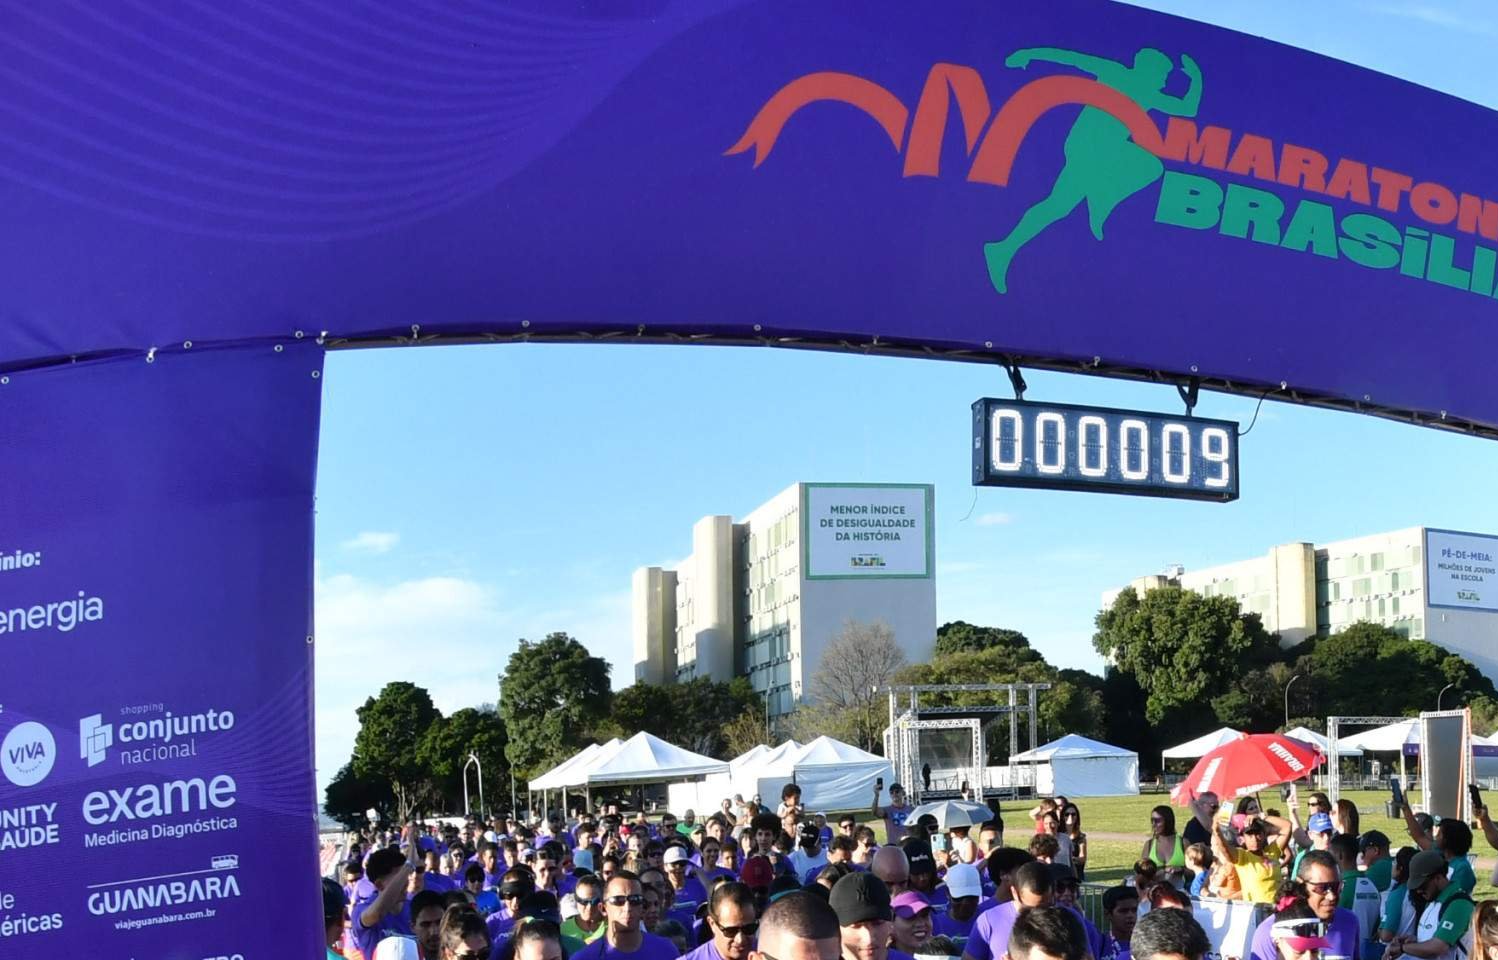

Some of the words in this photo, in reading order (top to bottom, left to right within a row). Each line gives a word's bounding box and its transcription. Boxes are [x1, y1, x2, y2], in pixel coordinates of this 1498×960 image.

[991, 408, 1229, 487] 000009
[830, 504, 868, 515] MENOR
[870, 502, 906, 515] ÍNDICE
[820, 518, 834, 528] DE
[836, 518, 916, 528] DESIGUALDADE
[835, 532, 850, 541] DA
[852, 529, 901, 541] HISTÓRIA
[118, 708, 235, 743] conjunto
[9, 741, 46, 765] VIVA
[120, 744, 197, 765] nacional
[82, 773, 237, 825] exame
[0, 824, 60, 851] AÚDE
[84, 827, 150, 848] Medicina
[151, 816, 238, 842] Diagnóstica
[87, 874, 242, 916] GUANABARA
[114, 907, 217, 931] viajeguanabara.com.br
